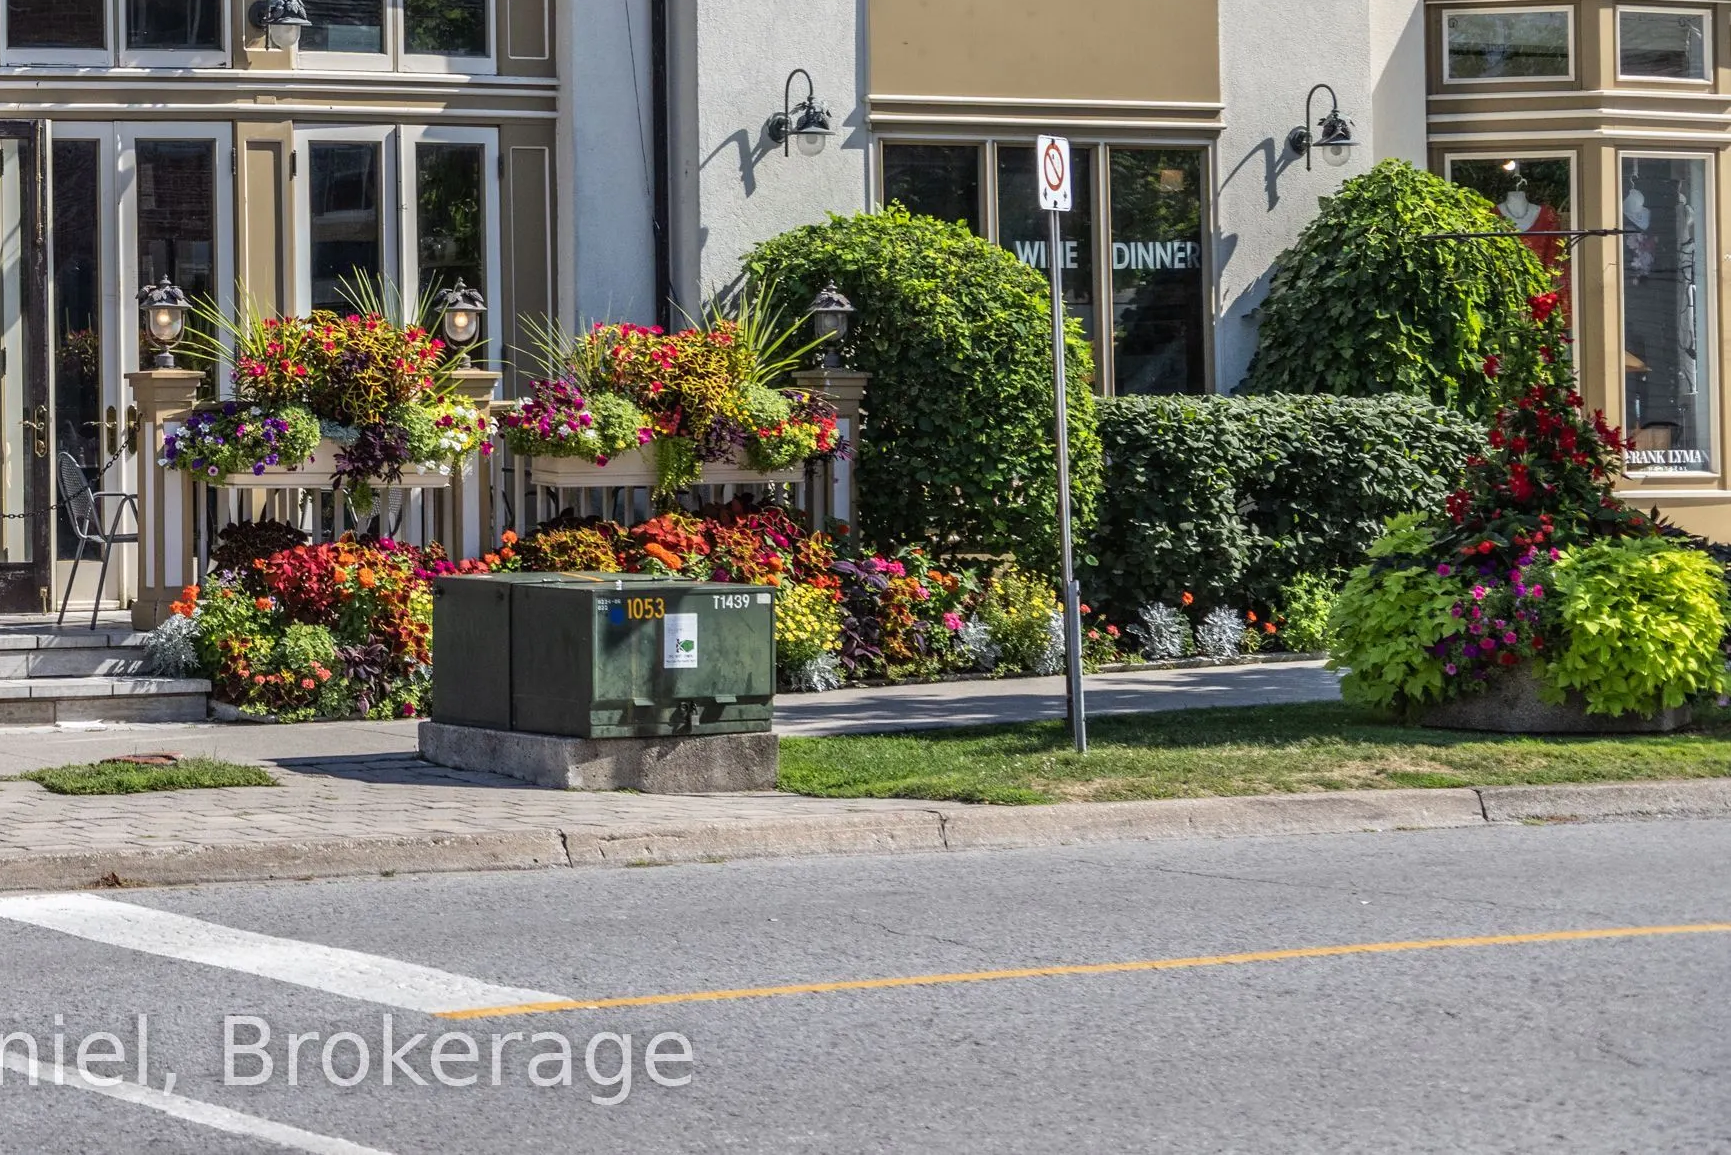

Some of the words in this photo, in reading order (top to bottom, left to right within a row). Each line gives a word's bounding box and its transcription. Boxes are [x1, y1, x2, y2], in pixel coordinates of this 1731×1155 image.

[1113, 241, 1200, 270] DINNER
[627, 598, 665, 619] 1053
[713, 595, 750, 609] T1439
